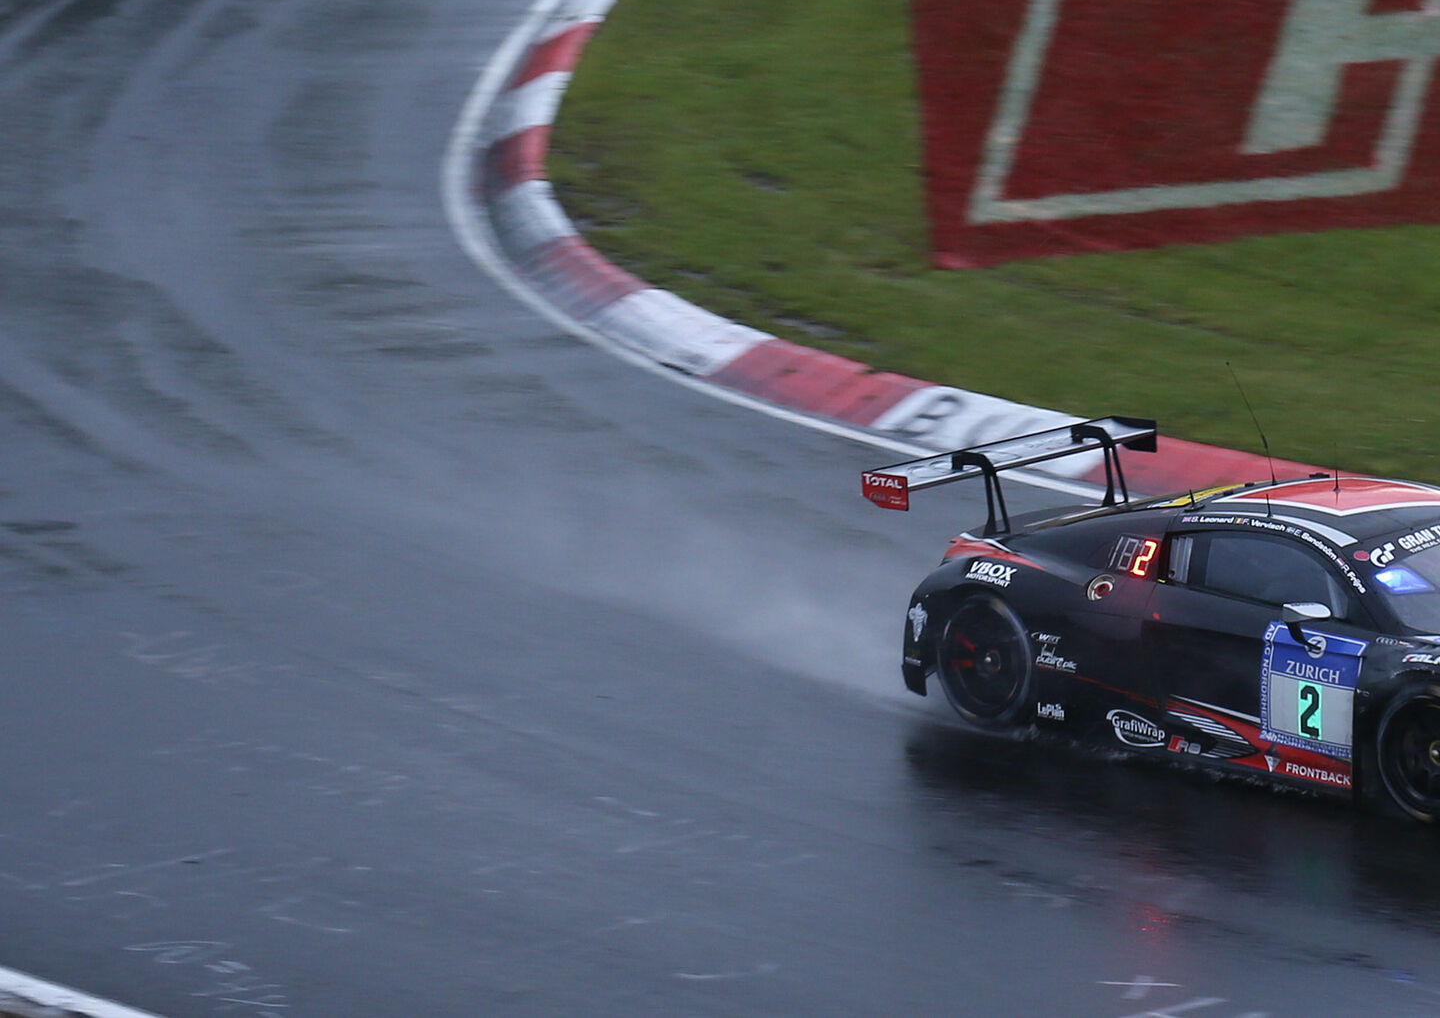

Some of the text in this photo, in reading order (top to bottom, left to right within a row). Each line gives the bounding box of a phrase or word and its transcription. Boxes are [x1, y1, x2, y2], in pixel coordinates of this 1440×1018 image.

[862, 473, 904, 490] TOTAL
[1200, 516, 1234, 524] Leonard
[1251, 519, 1286, 532] Vervisch
[1397, 528, 1434, 550] GRAN
[965, 572, 1011, 588] MOTORSPORT
[970, 561, 1018, 581] VBOX
[1285, 660, 1340, 684] ZURICH
[1300, 685, 1320, 737] 2
[1112, 715, 1165, 741] GrafiWrap
[1285, 762, 1352, 786] FRONTBACK
